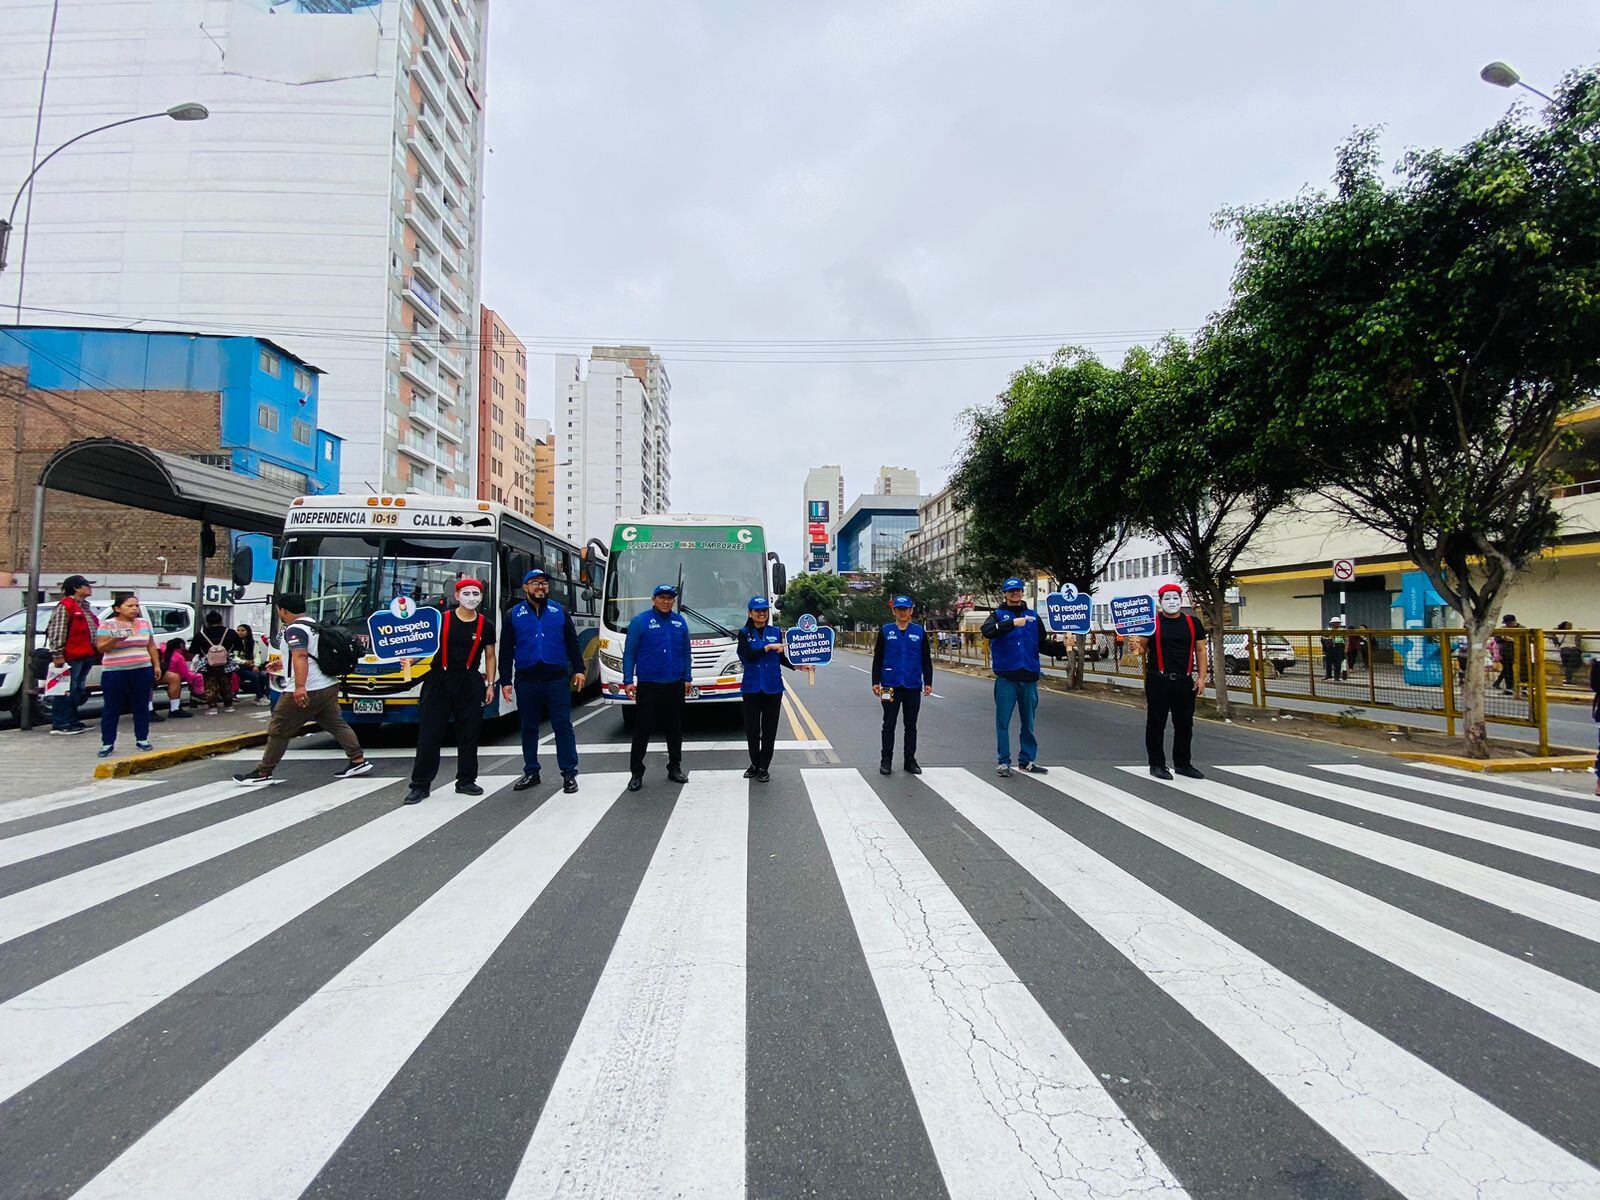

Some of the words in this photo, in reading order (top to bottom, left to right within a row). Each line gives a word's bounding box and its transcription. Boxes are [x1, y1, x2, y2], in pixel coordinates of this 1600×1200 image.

[290, 511, 366, 525] INDEPENDENCIA
[621, 526, 638, 541] C
[737, 529, 753, 543] C
[1049, 604, 1060, 613] YO
[1061, 603, 1088, 613] respeto
[1113, 598, 1149, 610] Regulariza
[1053, 613, 1061, 621] al
[1062, 611, 1087, 623] peatón
[1114, 609, 1122, 617] tu
[1122, 608, 1139, 618] pago
[377, 624, 393, 636] YO
[394, 620, 430, 634] respeto
[378, 636, 389, 647] el
[389, 631, 434, 646] semáforo
[792, 633, 817, 641] Mantén
[789, 641, 817, 649] distancia
[800, 646, 830, 655] vehículos
[394, 648, 407, 656] SAT
